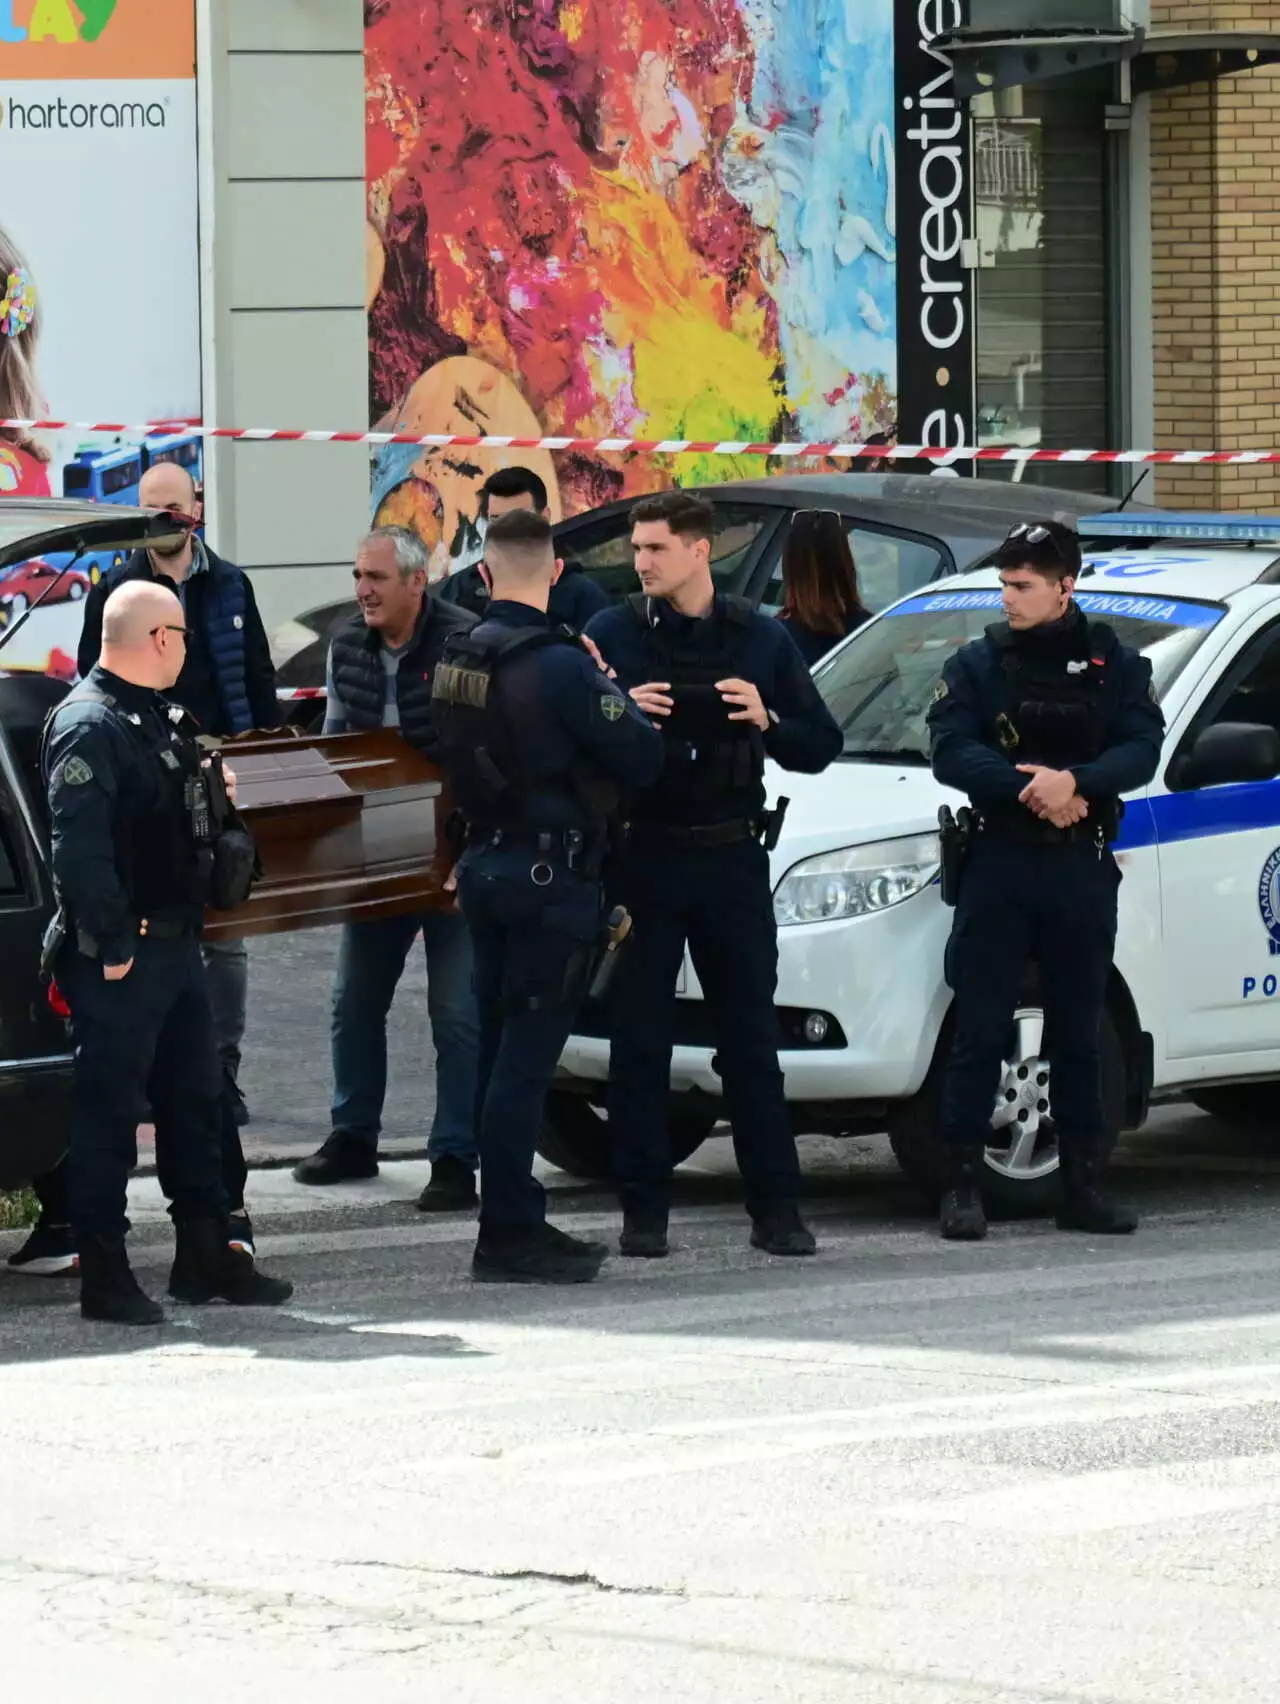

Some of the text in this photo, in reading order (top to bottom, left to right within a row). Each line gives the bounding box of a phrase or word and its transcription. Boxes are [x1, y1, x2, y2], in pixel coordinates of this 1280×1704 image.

[9, 97, 166, 129] hartorama
[903, 0, 964, 349] creative
[1072, 595, 1177, 619] ΤΥΝΟΜΙΑ
[1243, 974, 1277, 999] PO
